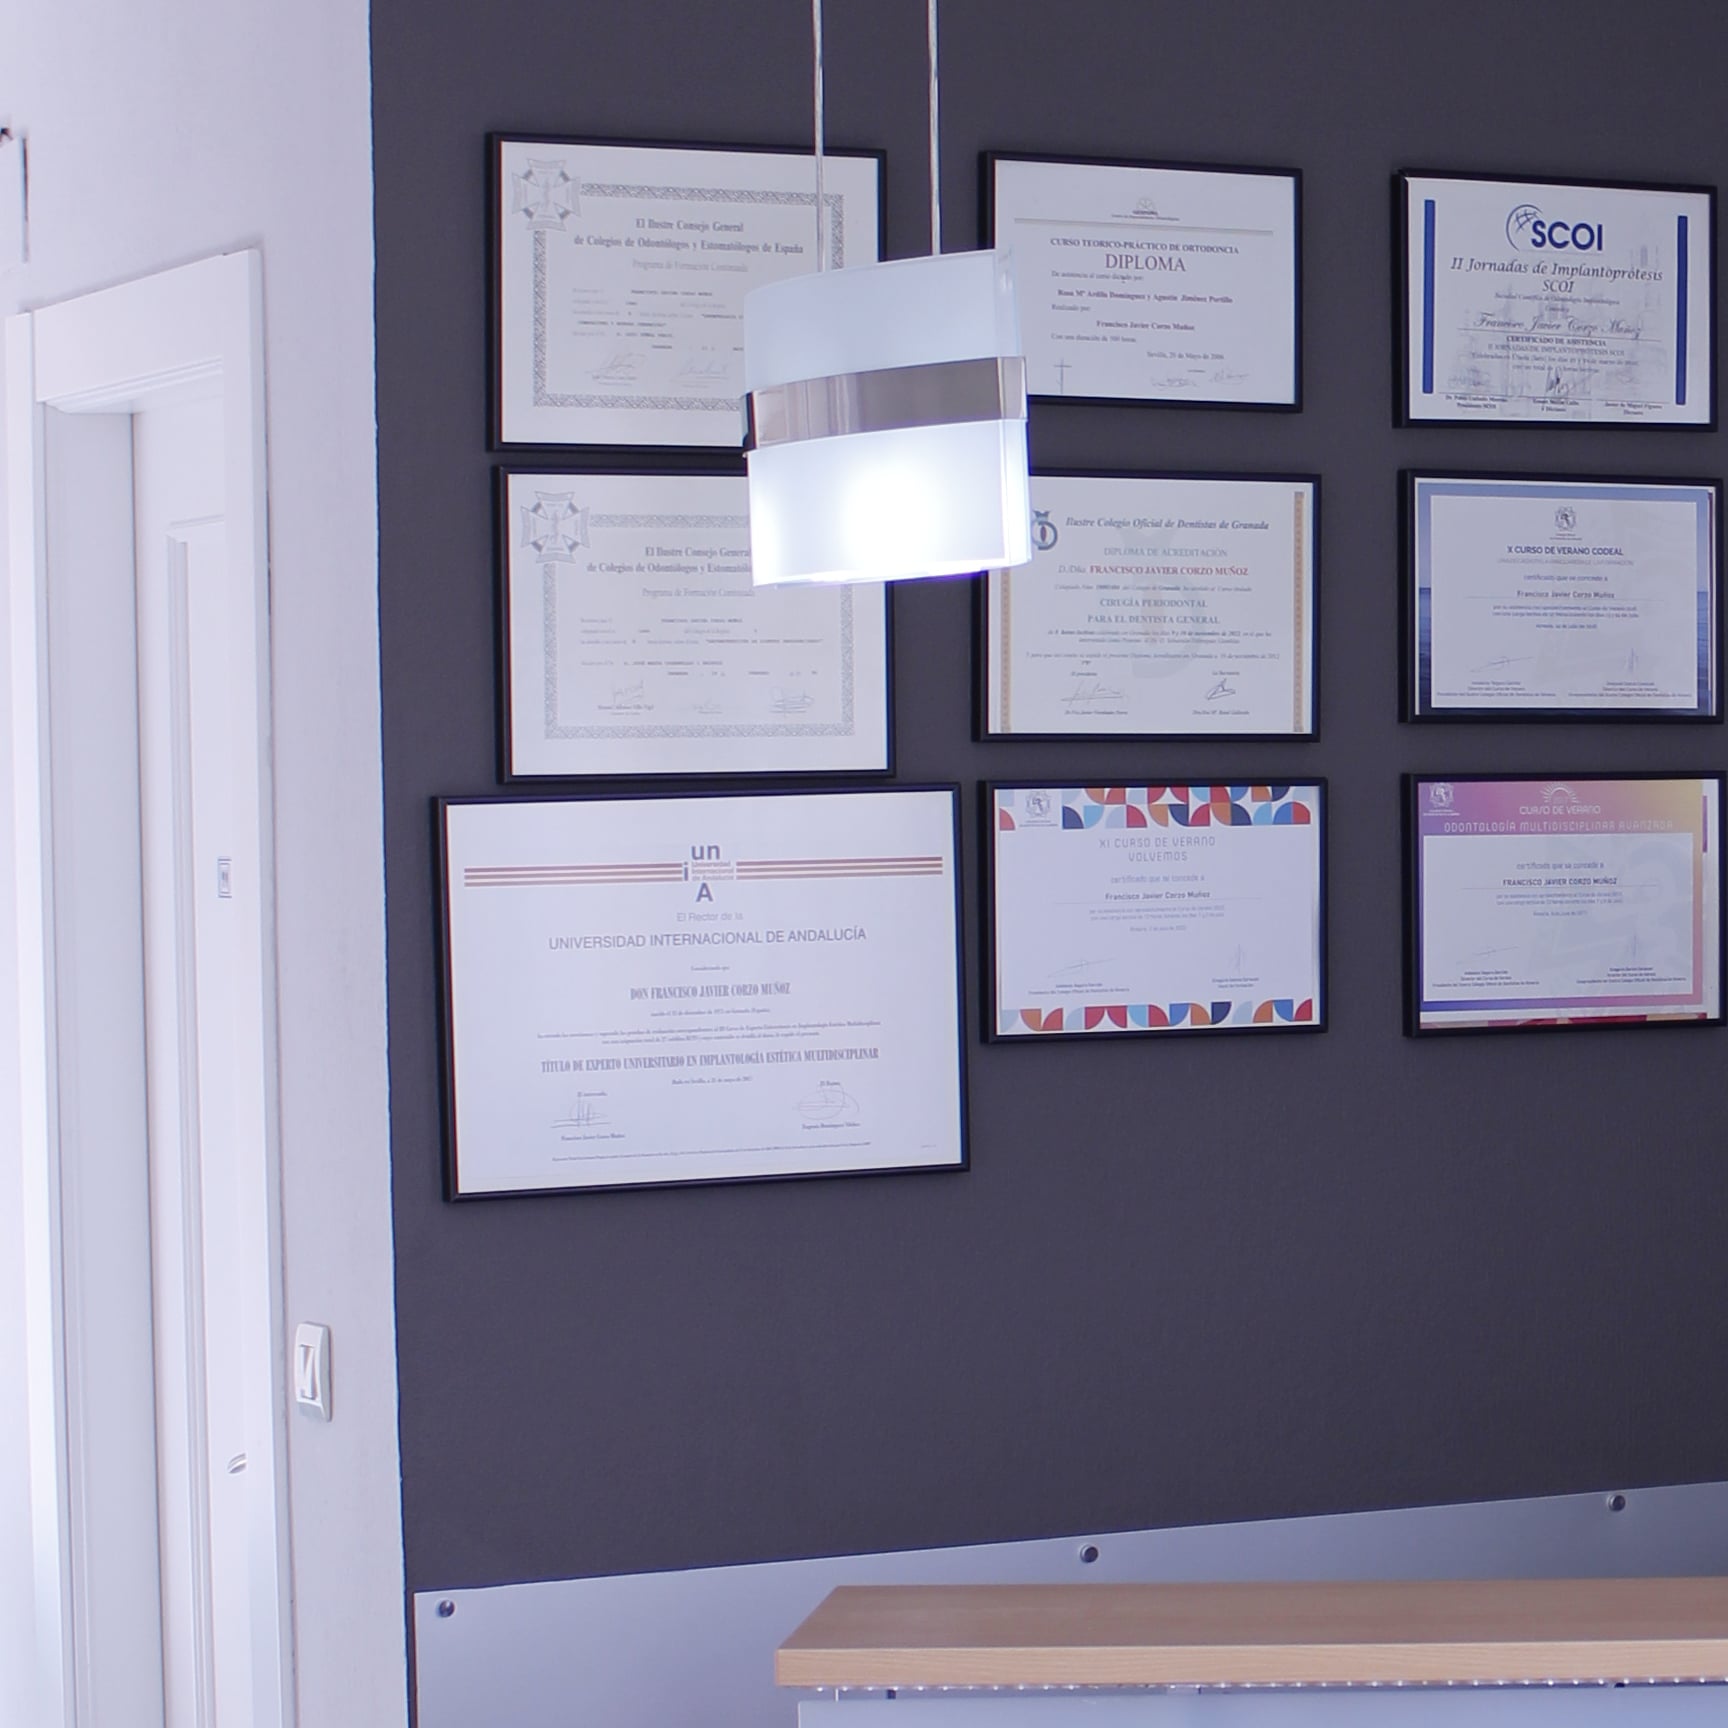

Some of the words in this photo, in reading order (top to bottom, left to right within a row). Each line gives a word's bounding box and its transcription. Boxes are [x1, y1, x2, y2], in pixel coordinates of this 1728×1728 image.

[636, 219, 645, 228] El
[648, 220, 673, 229] Ilustre
[677, 220, 710, 231] Consejo
[713, 222, 743, 232] General
[1531, 220, 1603, 251] SCOI
[1051, 238, 1080, 247] CURSO
[1169, 243, 1180, 251] DE
[1182, 245, 1239, 254] ORTODONCIA
[1106, 254, 1186, 271] DIPLOMA
[1451, 257, 1463, 269] II
[1467, 258, 1528, 273] Jornadas
[1533, 261, 1548, 274] de
[1543, 279, 1574, 293] SCOI
[1066, 518, 1094, 527] Ilustre
[1097, 518, 1130, 529] Colegio
[1133, 519, 1162, 528] Oficial
[1178, 520, 1216, 529] Dentistas
[1219, 521, 1228, 529] de
[1232, 521, 1268, 530] Granada
[1515, 546, 1542, 554] CURSO
[1558, 547, 1590, 555] VERANO
[1090, 566, 1142, 575] FRANCISCO
[1145, 567, 1177, 575] JAVIER
[1181, 567, 1212, 575] CORZO
[1215, 566, 1248, 575] MUÑOZ
[1100, 598, 1139, 607] CIRUGÍA
[1142, 599, 1207, 607] PERIODONTAL
[1115, 615, 1127, 623] EL
[1520, 806, 1549, 815] CURSO
[1554, 806, 1564, 814] DE
[1567, 806, 1600, 815] VERANO
[1445, 821, 1515, 832] ODONTOLOGÍA
[1520, 821, 1615, 831] MULTIDISCIPLINAR
[1619, 820, 1672, 830] AVANZADA
[1099, 840, 1110, 848] XI
[1114, 838, 1150, 848] CURSO
[1155, 838, 1167, 847] DE
[1172, 836, 1215, 846] VERANO
[691, 844, 720, 860] un
[1129, 851, 1187, 862] VOLVEMOS
[1545, 878, 1567, 886] JAVIER
[1593, 877, 1616, 885] MUÑOZ
[696, 883, 713, 902] A
[677, 913, 686, 921] El
[689, 912, 718, 921] Rector
[734, 912, 743, 920] la
[549, 935, 645, 950] UNIVERSIDAD
[650, 932, 762, 946] INTERNACIONAL
[766, 932, 785, 943] DE
[788, 926, 866, 942] ANDALUCÍA
[631, 987, 648, 1000] DON
[651, 986, 698, 999] FRANCISCO
[700, 985, 729, 997] JAVIER
[731, 985, 758, 996] CORZO
[761, 983, 790, 996] MUÑOZ
[573, 1060, 583, 1071] DE
[586, 1058, 622, 1071] EXPERTO
[624, 1057, 685, 1070] UNIVERSITARIO
[687, 1056, 698, 1066] EN
[700, 1051, 764, 1066] IMPLANTOLOGÍA
[766, 1050, 801, 1063] ESTÉTICA
[804, 1048, 879, 1061] MULTIDISCIPLINAR
